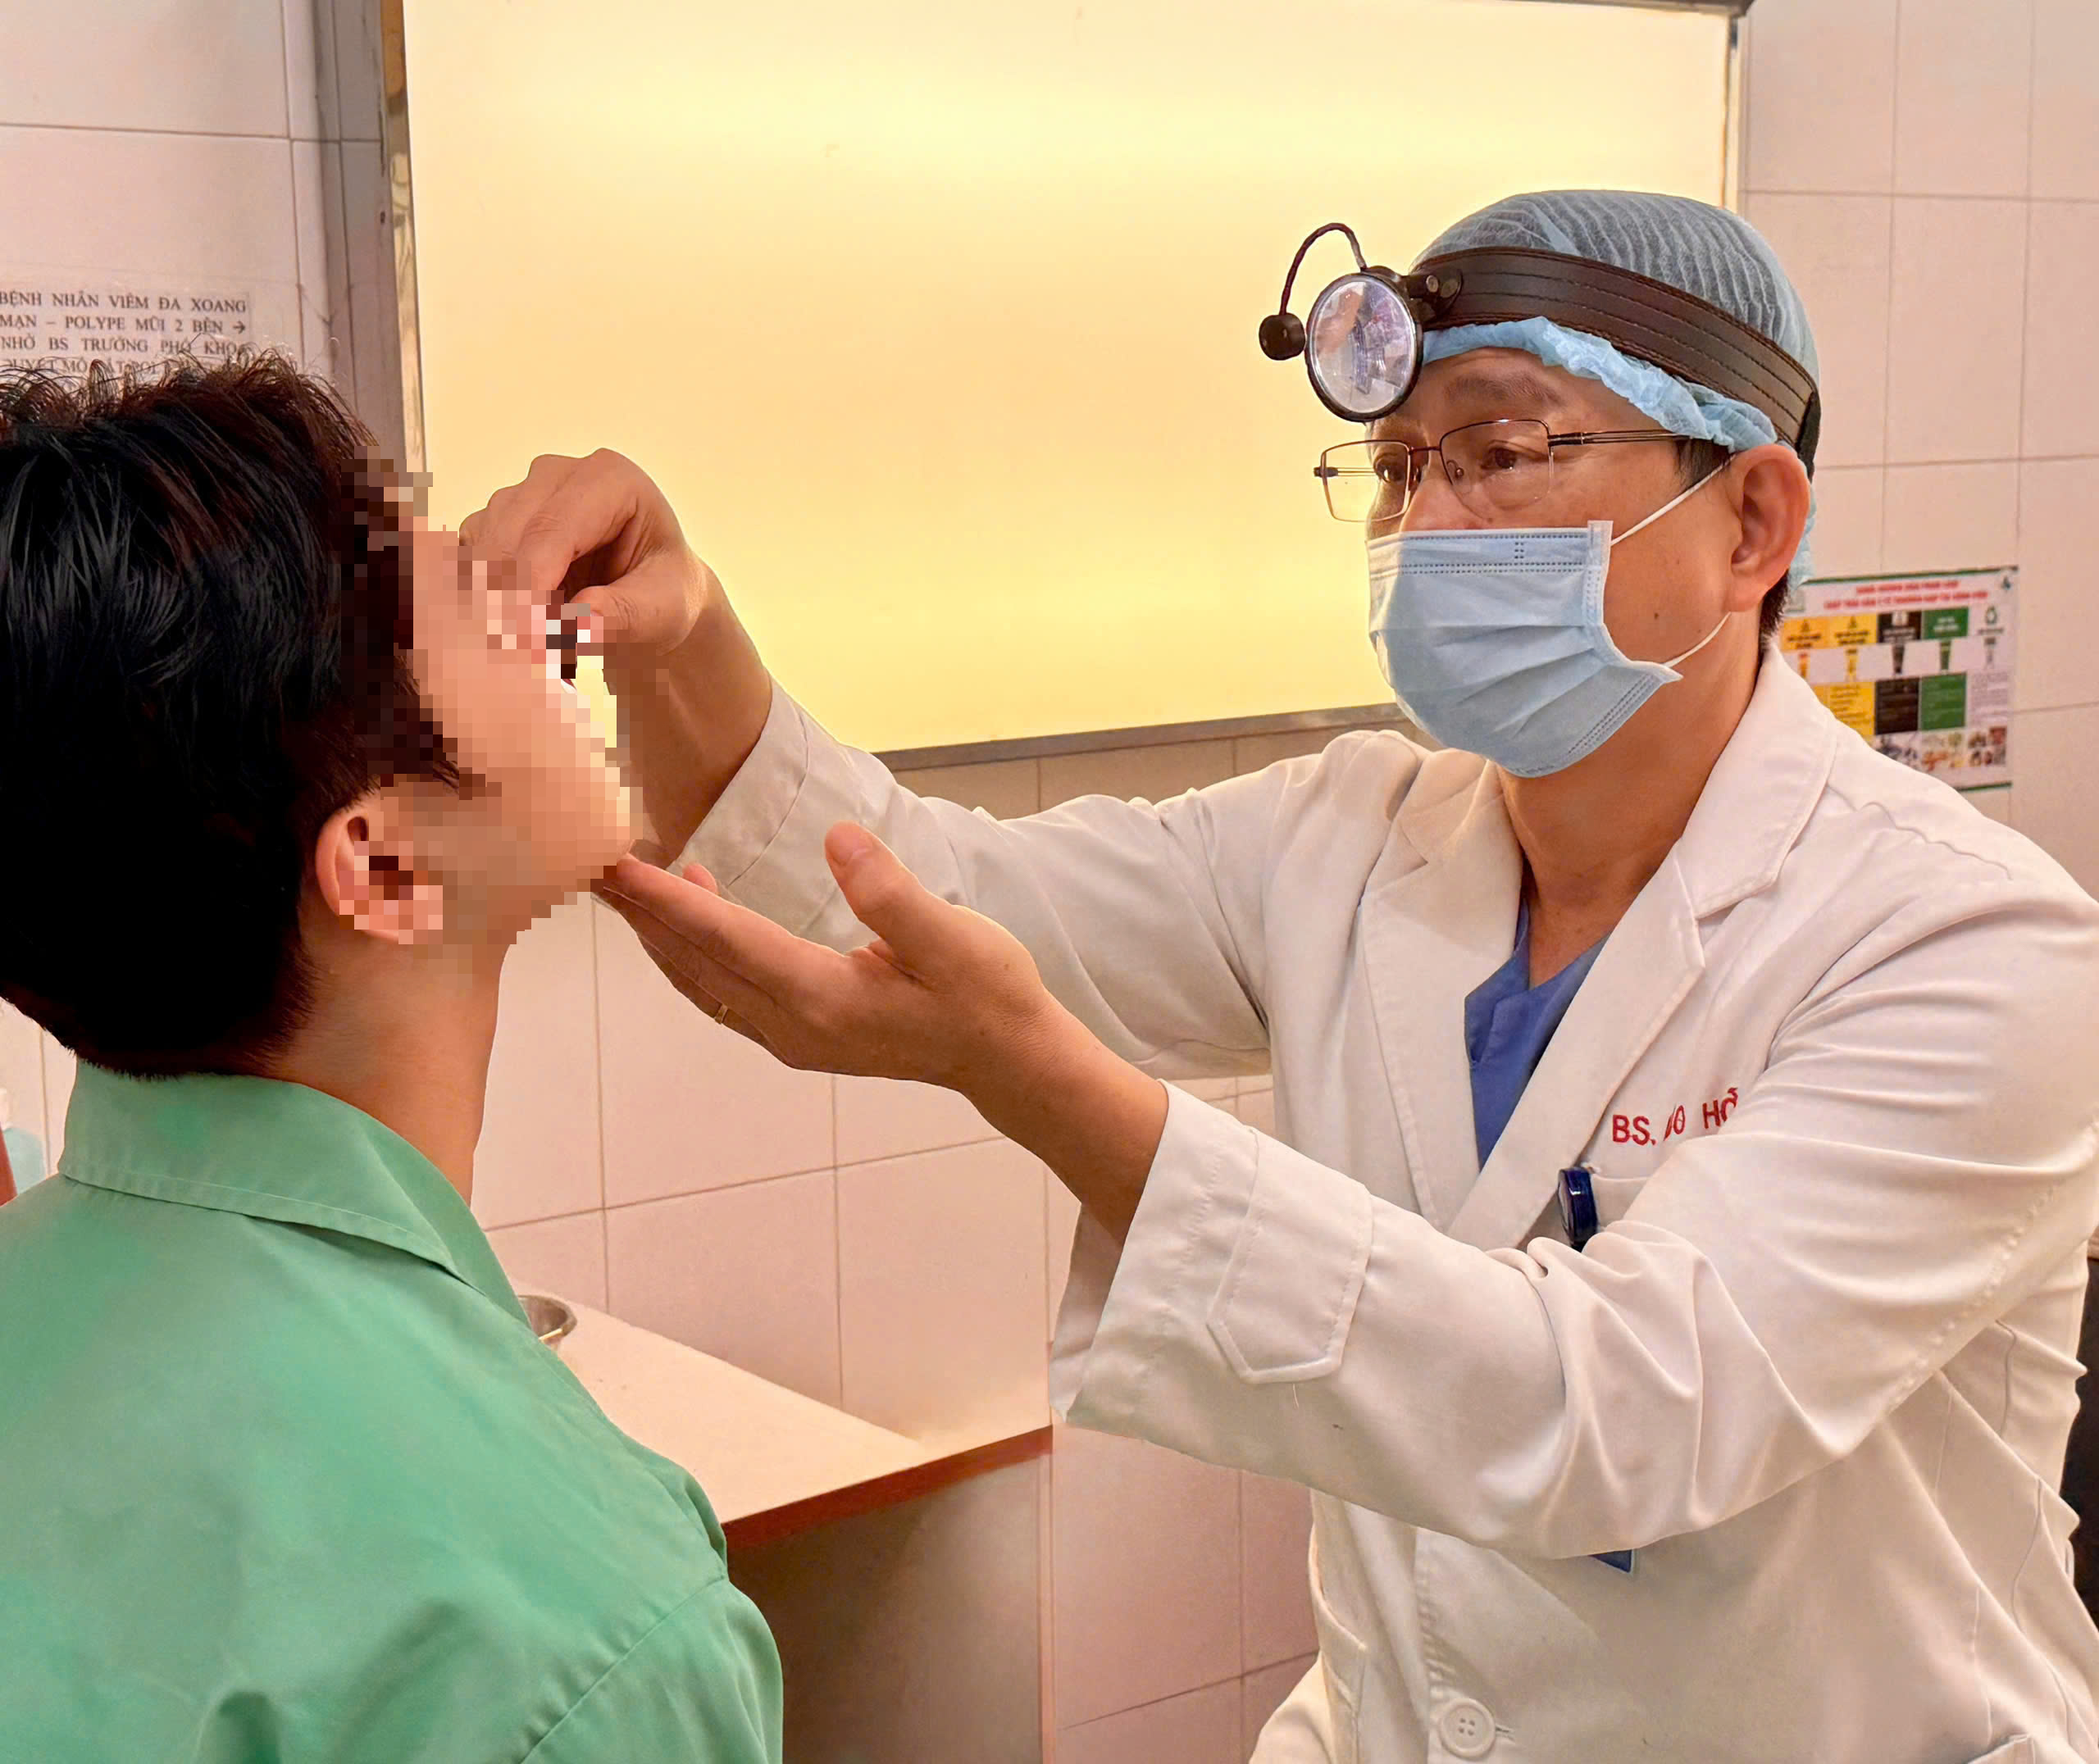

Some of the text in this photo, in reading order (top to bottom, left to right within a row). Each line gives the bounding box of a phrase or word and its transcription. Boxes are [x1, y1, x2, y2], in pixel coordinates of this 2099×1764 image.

[52, 290, 99, 307] NHÂN
[108, 292, 149, 309] VIÊM
[159, 296, 180, 310] ĐA
[190, 298, 246, 313] XOANG
[0, 314, 37, 330] MẠN
[65, 315, 125, 330] POLYPE
[175, 319, 183, 332] 2
[193, 316, 223, 334] BÊN
[48, 337, 69, 351] BS
[204, 340, 247, 356] KHO
[1613, 1115, 1656, 1145] BS.
